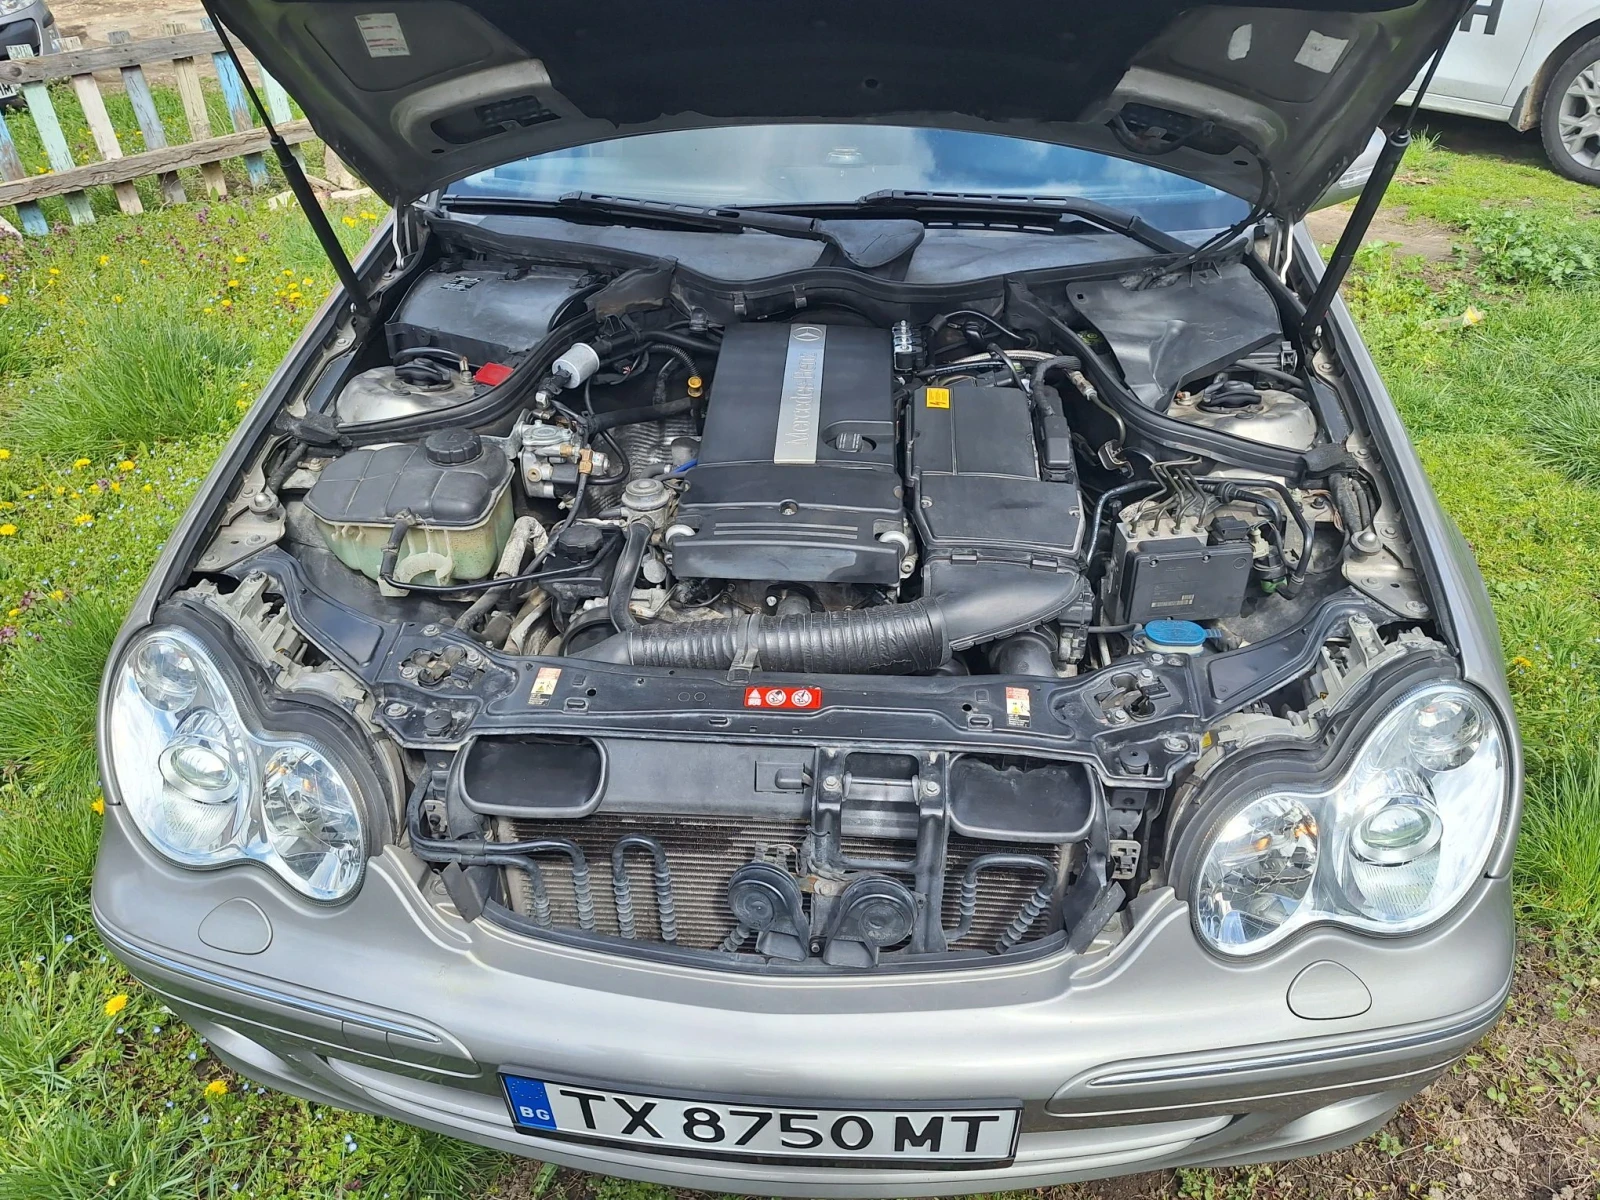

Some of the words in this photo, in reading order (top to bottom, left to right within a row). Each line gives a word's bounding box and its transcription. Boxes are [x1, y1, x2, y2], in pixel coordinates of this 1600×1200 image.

[519, 1105, 550, 1121] BG
[560, 1089, 664, 1139] TX
[682, 1107, 874, 1151] 8750
[893, 1115, 1000, 1153] MT
